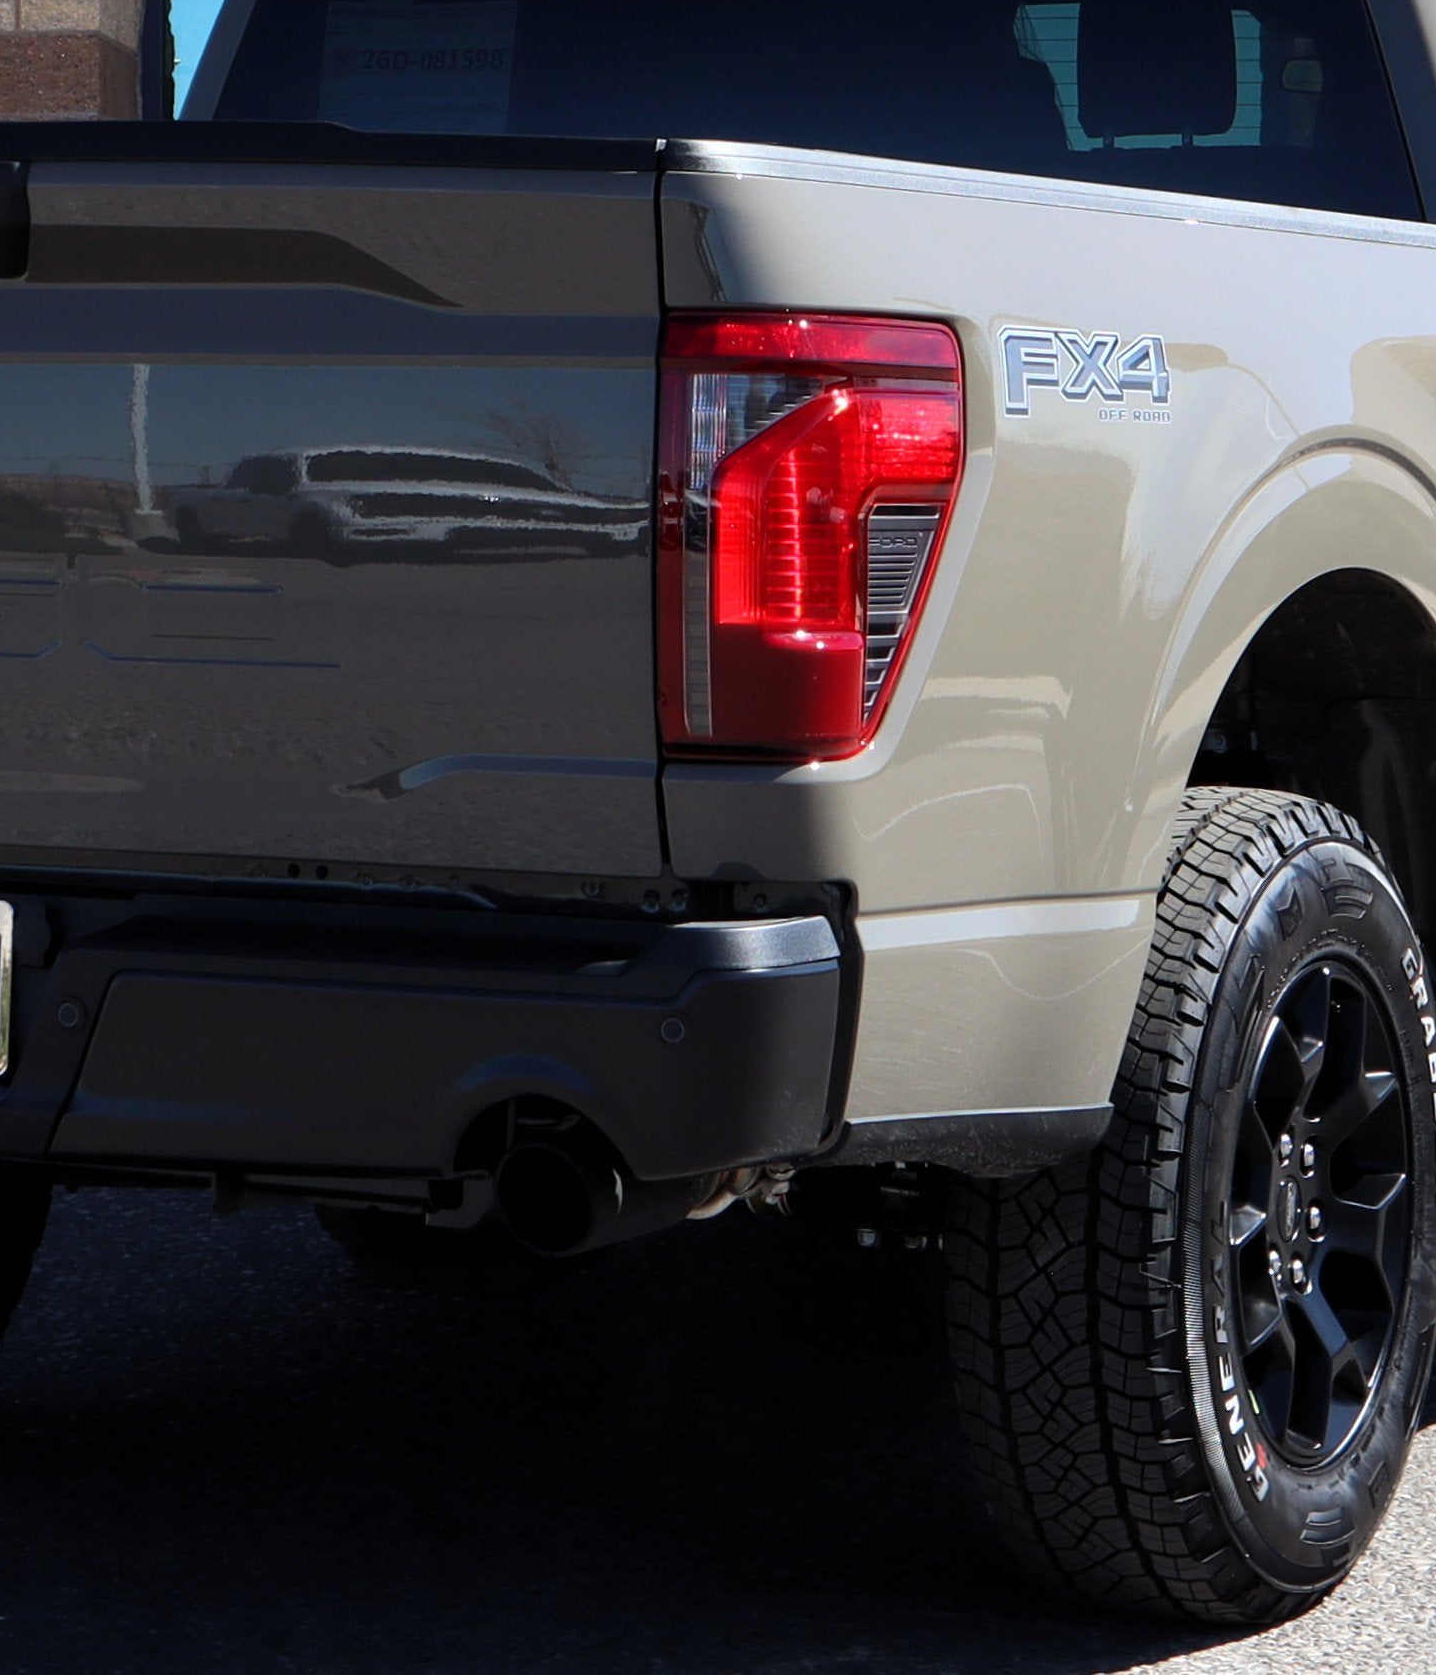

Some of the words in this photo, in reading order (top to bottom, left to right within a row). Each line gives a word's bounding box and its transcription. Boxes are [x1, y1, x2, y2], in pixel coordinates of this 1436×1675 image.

[997, 325, 1171, 418] FX4
[1098, 408, 1127, 422] OFF
[1133, 410, 1172, 423] ROAD
[1211, 1200, 1270, 1503] GENERAL
